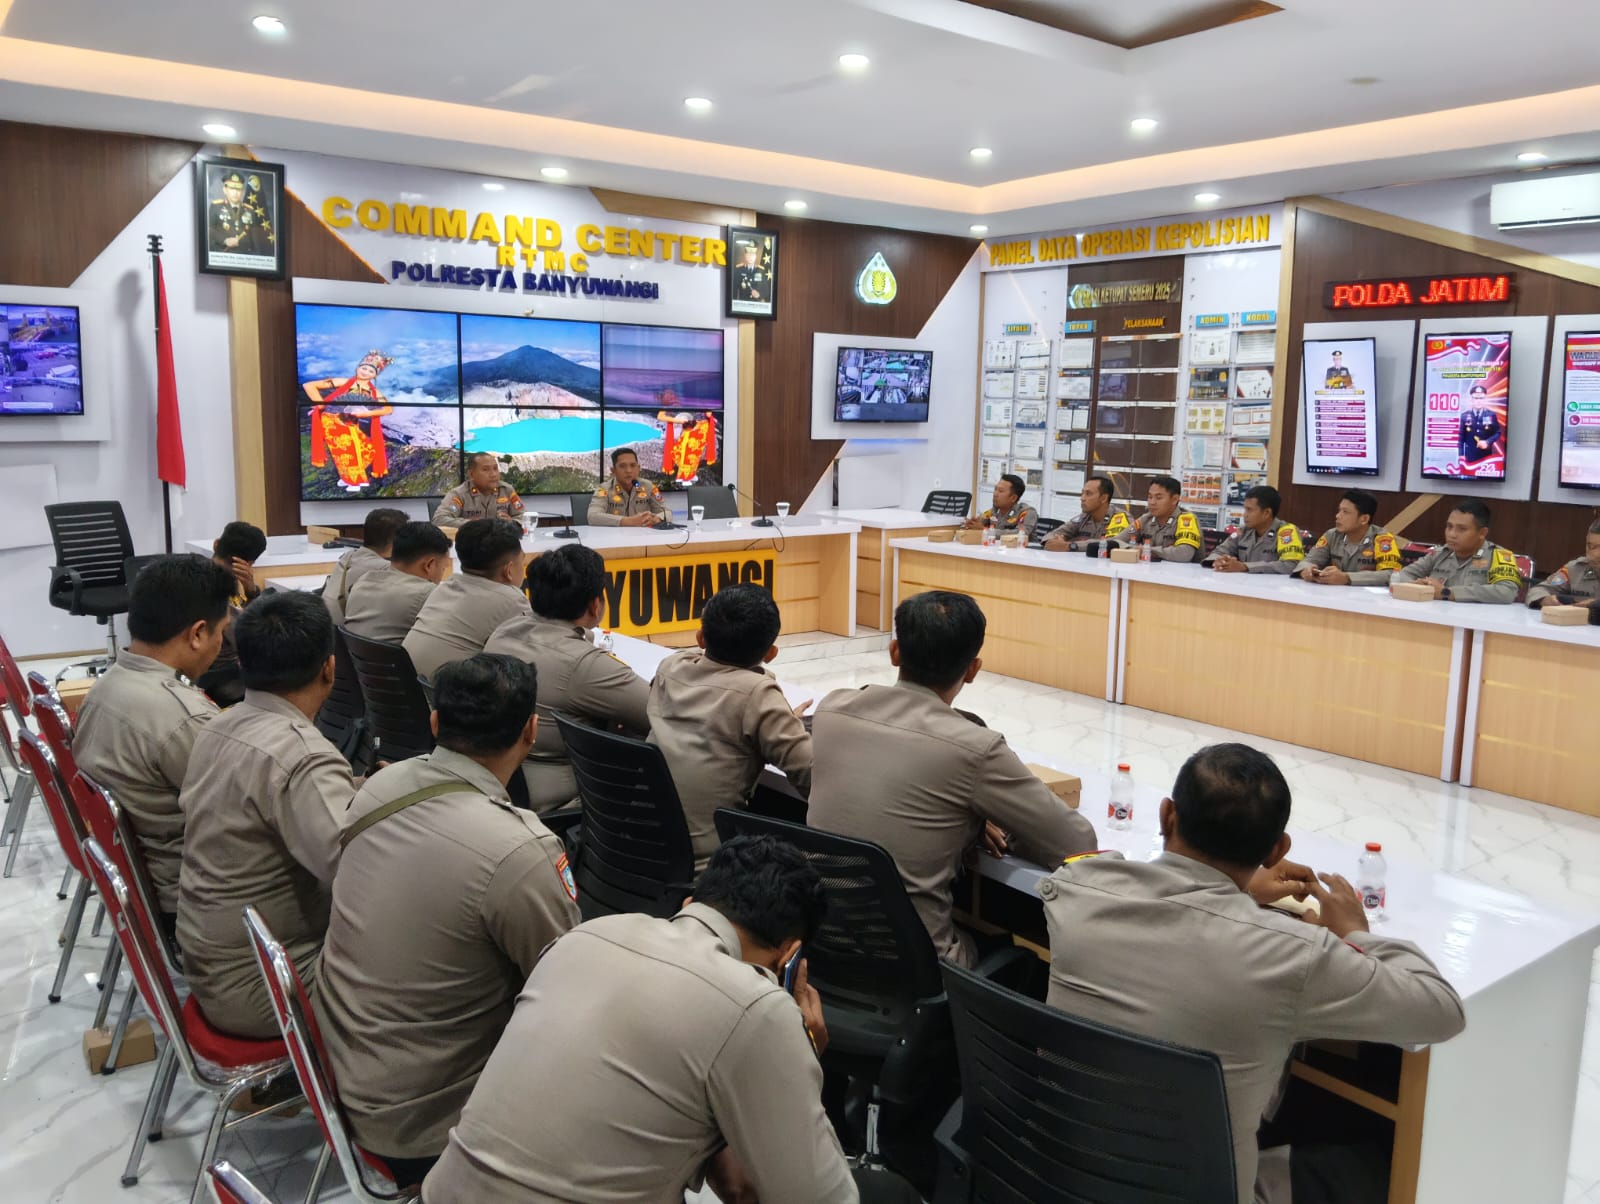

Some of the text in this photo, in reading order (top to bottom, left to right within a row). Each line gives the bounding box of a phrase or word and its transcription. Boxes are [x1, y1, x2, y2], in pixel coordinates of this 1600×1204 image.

[322, 195, 728, 266] COMMAND CENTER
[989, 214, 1271, 267] PANEL DATA OPERASI KEPOLISIAN
[497, 245, 588, 273] RTMC
[391, 260, 659, 300] POLRESTA BANYUWANGI
[1101, 285, 1127, 303] KETUPAT
[1129, 283, 1154, 302] SEMERU
[1155, 282, 1171, 301] 2025
[1333, 276, 1509, 308] POLDA JATIM
[1430, 394, 1459, 410] 110
